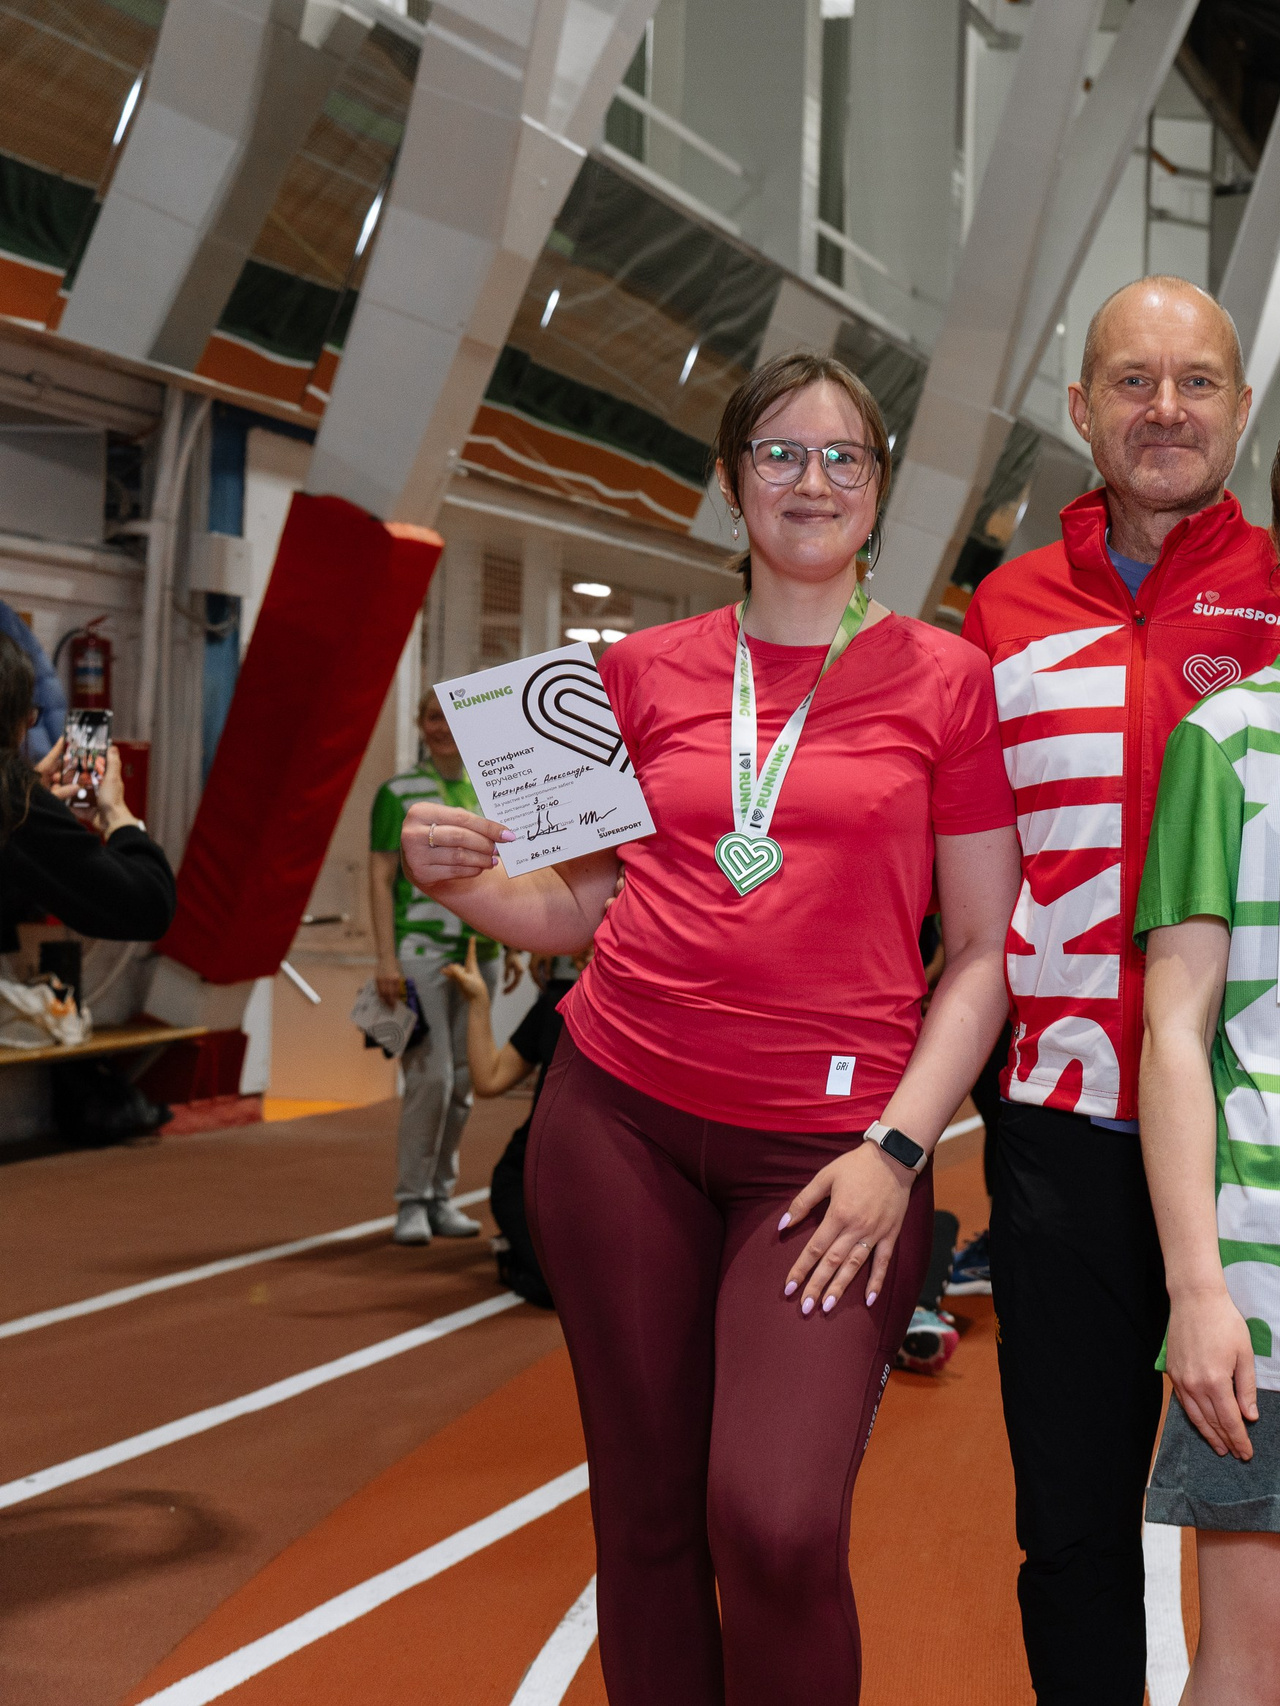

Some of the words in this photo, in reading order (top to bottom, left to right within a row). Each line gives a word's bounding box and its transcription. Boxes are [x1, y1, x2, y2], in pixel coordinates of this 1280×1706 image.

[449, 691, 455, 700] I
[739, 658, 751, 717] RUNNING
[453, 685, 513, 710] RUNNING
[478, 746, 535, 768] Сертификат
[481, 762, 515, 777] бегуна
[485, 768, 533, 787] вручается
[756, 744, 790, 808] RUNNING
[534, 796, 539, 805] 3
[536, 799, 559, 811] 20:40
[599, 821, 641, 838] SUPERSPORT
[530, 845, 561, 860] 26.10.24
